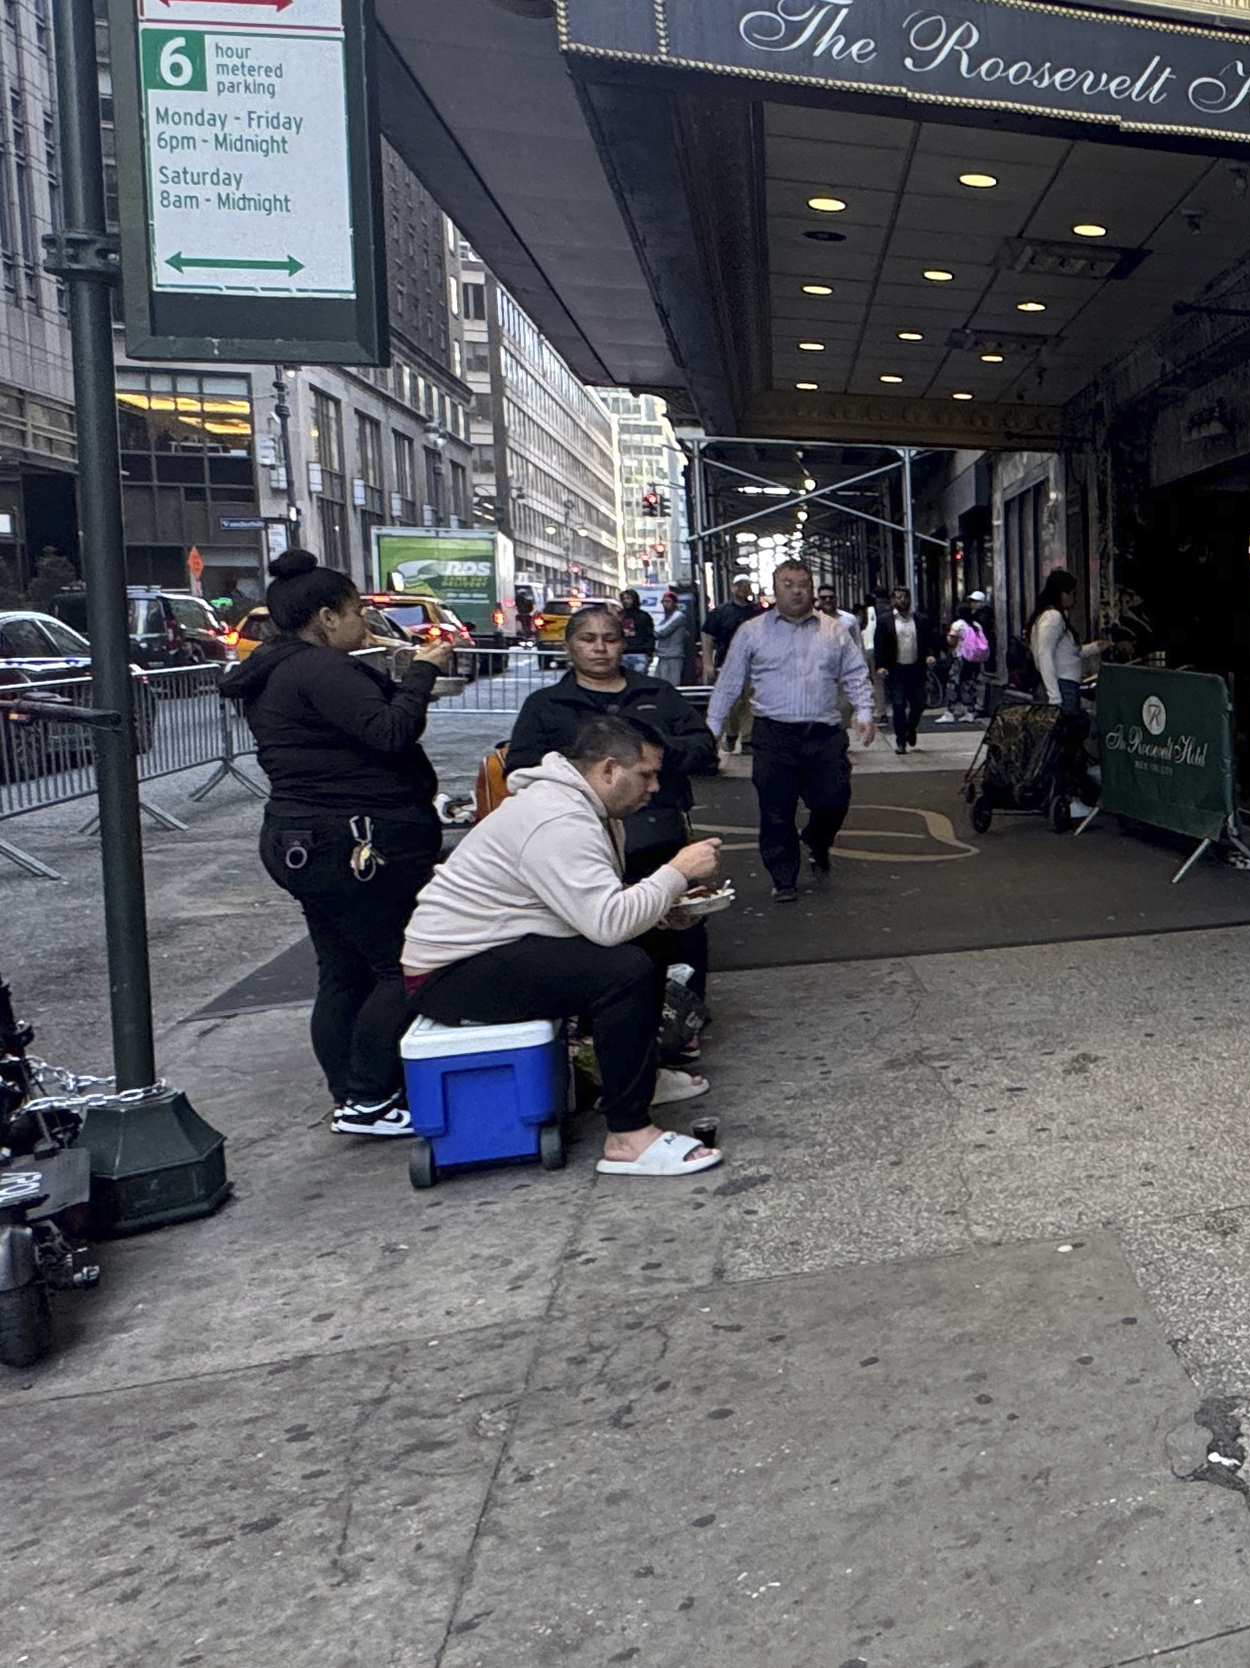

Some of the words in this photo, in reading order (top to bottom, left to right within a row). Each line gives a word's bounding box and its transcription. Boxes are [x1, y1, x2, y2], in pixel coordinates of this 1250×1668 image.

[160, 36, 193, 87] 6
[215, 43, 252, 59] hour
[739, 0, 877, 64] The
[902, 9, 1177, 105] Roosevelt
[216, 61, 283, 79] metered
[217, 79, 276, 99] parking
[155, 106, 228, 131] Monday
[247, 110, 303, 135] Friday
[157, 131, 197, 154] 6pm
[214, 133, 289, 157] Midnight
[158, 165, 243, 191] Saturday
[160, 190, 200, 209] 8am
[217, 192, 291, 216] Midnight
[446, 561, 492, 576] RDS
